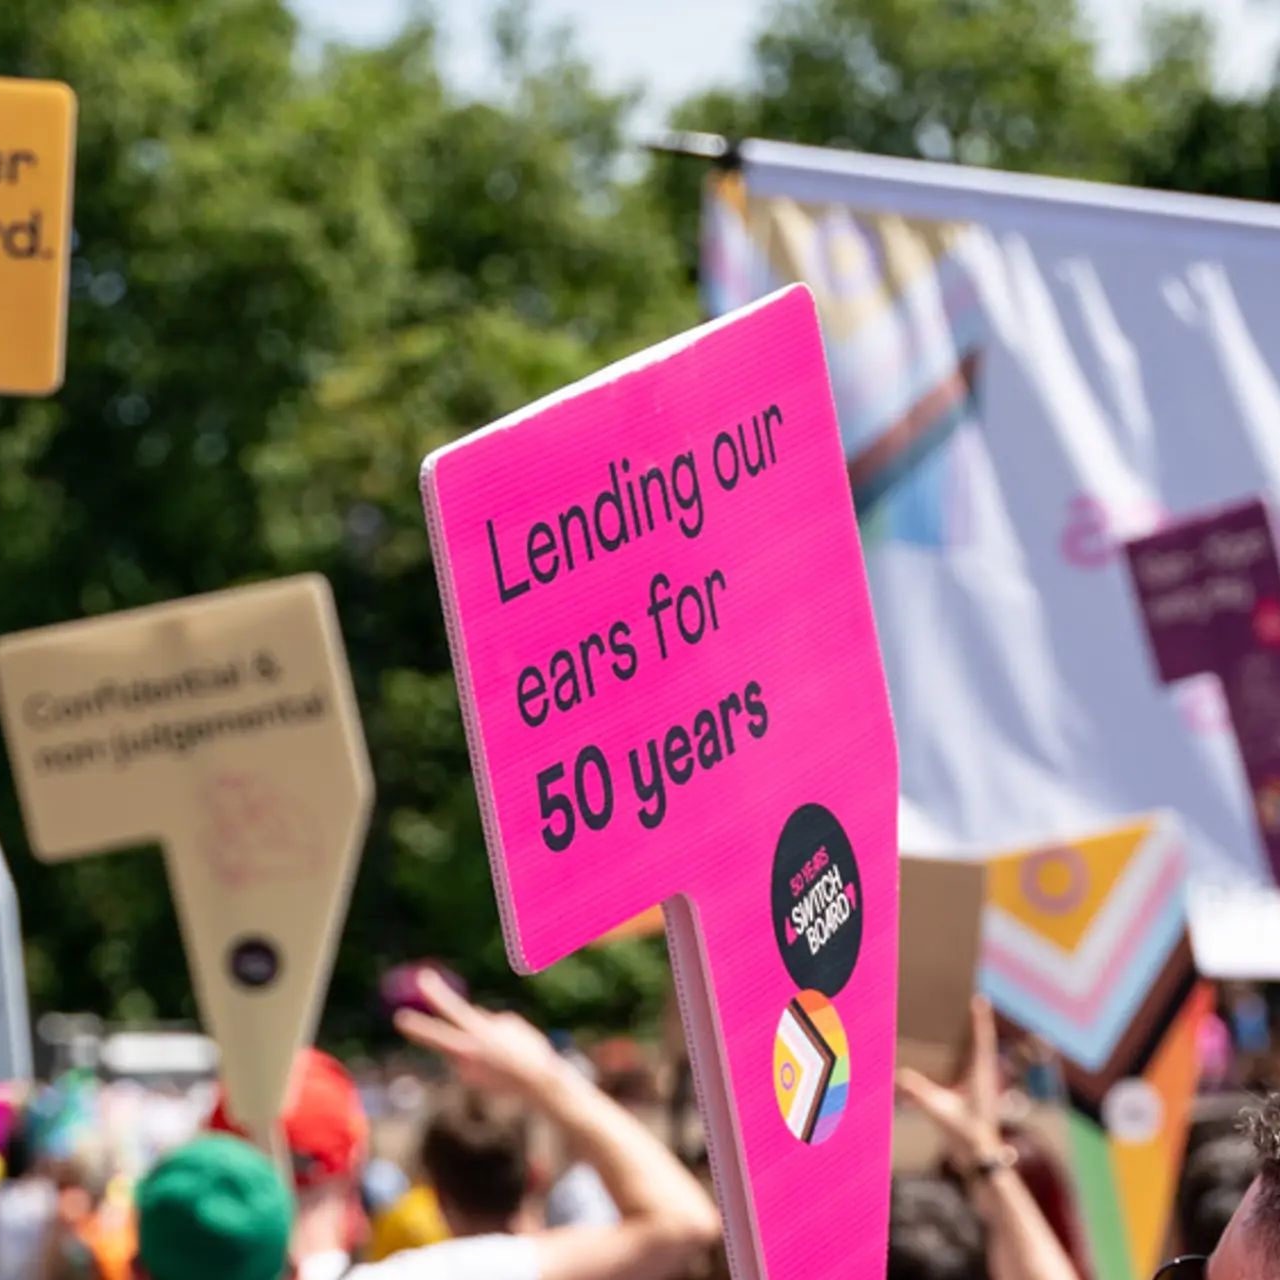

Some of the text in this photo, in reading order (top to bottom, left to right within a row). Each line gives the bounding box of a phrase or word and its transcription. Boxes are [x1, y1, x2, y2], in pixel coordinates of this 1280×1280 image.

[485, 403, 784, 604] Lending our
[516, 572, 727, 728] ears for
[535, 679, 770, 853] 50 years
[790, 845, 830, 898] 50 YEARS
[791, 863, 843, 936] SWITCH
[806, 892, 851, 956] BOARD
